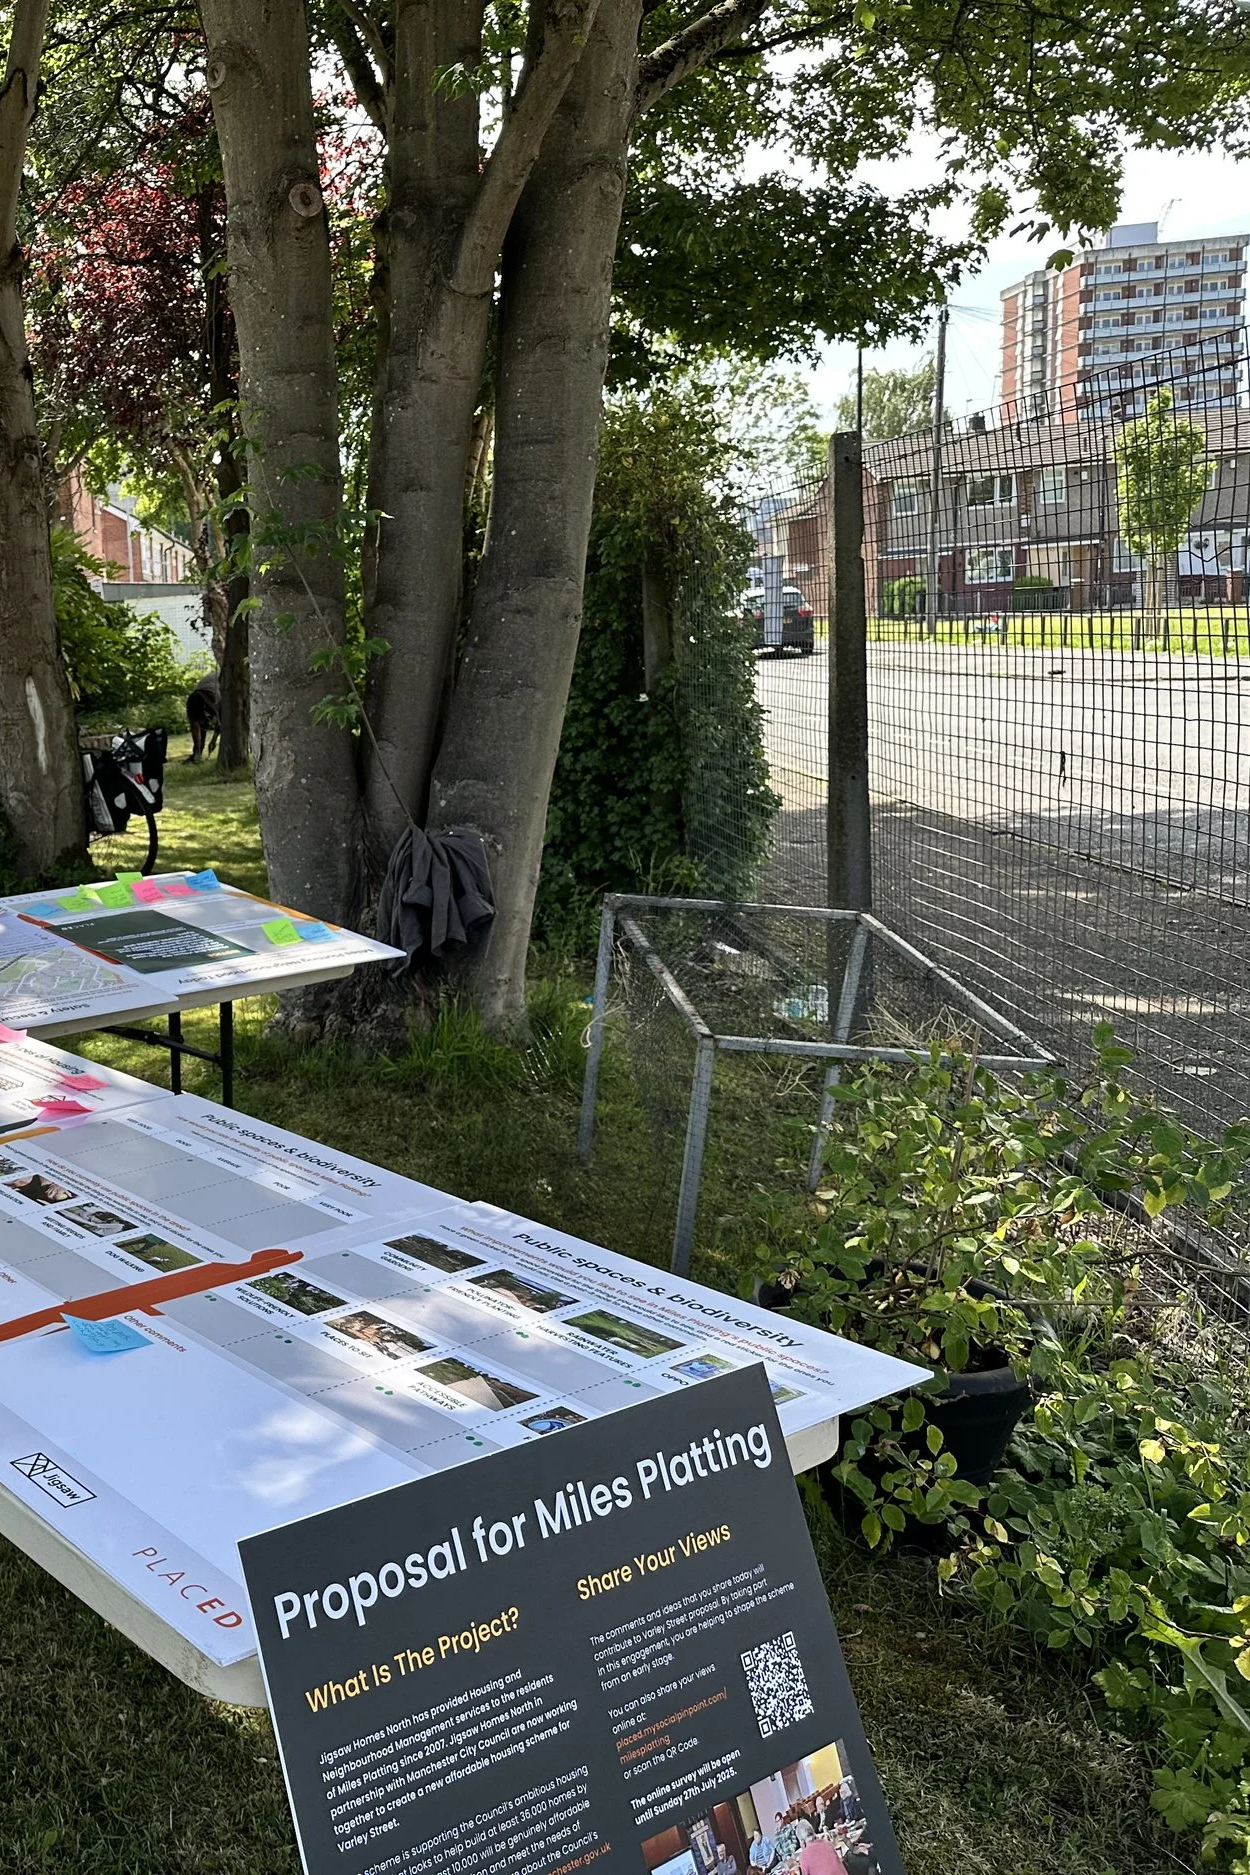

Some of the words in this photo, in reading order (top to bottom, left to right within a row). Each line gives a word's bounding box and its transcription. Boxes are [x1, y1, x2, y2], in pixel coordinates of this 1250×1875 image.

[200, 1113, 241, 1131] Public
[237, 1129, 286, 1149] spaces
[282, 1147, 299, 1155] &
[294, 1151, 382, 1188] biodiversity
[104, 1249, 121, 1259] DOG
[117, 1256, 145, 1273] WALKING
[234, 1286, 296, 1318] WILDLIFE-FRIENDLY
[511, 1232, 573, 1259] Public
[571, 1257, 647, 1288] spaces
[646, 1286, 666, 1297] &
[665, 1293, 804, 1348] biodiversity
[123, 1314, 147, 1329] Other
[143, 1327, 187, 1353] comments
[318, 1330, 350, 1347] PLACES
[348, 1344, 360, 1352] TO
[358, 1350, 372, 1358] SIT
[538, 1325, 590, 1350] HARVESTING
[587, 1347, 634, 1369] FEATURES
[566, 1331, 619, 1356] RAINWATER
[408, 1384, 456, 1411] PATHWAYS
[417, 1381, 468, 1408] ACCESSIBLE
[42, 1473, 81, 1500] Jigsaw
[274, 1527, 466, 1639] Proposal
[472, 1513, 526, 1562] for
[534, 1477, 632, 1538] Miles
[636, 1423, 771, 1499] Platting
[131, 1546, 243, 1628] PLACED
[577, 1566, 632, 1599] Share
[633, 1546, 675, 1575] Your
[678, 1525, 730, 1556] Views
[590, 1635, 604, 1645] The
[605, 1617, 645, 1639] comments
[646, 1609, 661, 1621] and
[662, 1601, 682, 1614] ideas
[682, 1593, 698, 1605] that
[698, 1589, 711, 1601] you
[712, 1579, 732, 1593] share
[732, 1570, 752, 1584] today
[594, 1639, 632, 1661] contribute
[633, 1635, 641, 1643] to
[642, 1624, 664, 1639] Varley
[666, 1613, 687, 1629] Street
[721, 1595, 729, 1604] By
[730, 1586, 752, 1600] taking
[752, 1578, 767, 1593] part
[597, 1667, 605, 1676] in
[606, 1660, 620, 1672] this
[670, 1632, 684, 1645] you
[685, 1626, 697, 1636] are
[698, 1614, 725, 1630] helping
[724, 1610, 732, 1618] to
[733, 1600, 754, 1615] shape
[755, 1594, 767, 1604] the
[767, 1582, 794, 1599] scheme
[305, 1670, 369, 1712] What
[372, 1664, 391, 1686] Is
[394, 1647, 434, 1675] The
[438, 1607, 518, 1658] Project?
[601, 1677, 620, 1690] from
[621, 1672, 631, 1682] an
[632, 1663, 650, 1676] early
[651, 1653, 674, 1668] stage.
[319, 1744, 351, 1764] Jigsaw
[353, 1730, 385, 1749] Homes
[386, 1718, 411, 1735] North
[412, 1711, 429, 1724] has
[430, 1691, 468, 1719] provided
[469, 1678, 504, 1699] Housing
[505, 1668, 521, 1683] and
[608, 1707, 623, 1718] You
[624, 1700, 639, 1711] can
[640, 1692, 655, 1704] also
[656, 1681, 677, 1696] share
[678, 1673, 694, 1689] your
[695, 1664, 715, 1678] views
[322, 1743, 394, 1782] Neighbourhood
[395, 1717, 454, 1750] Management
[455, 1702, 490, 1723] services
[491, 1698, 500, 1707] to
[501, 1691, 515, 1703] the
[516, 1674, 553, 1696] residents
[326, 1786, 335, 1799] of
[337, 1778, 361, 1795] Miles
[362, 1762, 398, 1783] Platting
[399, 1751, 423, 1767] since
[424, 1738, 448, 1756] 2007.
[449, 1725, 478, 1745] Jigsaw
[479, 1712, 509, 1731] Homes
[510, 1700, 533, 1717] North
[533, 1697, 542, 1706] in
[612, 1718, 635, 1734] online
[620, 1735, 670, 1764] milesplatting
[330, 1787, 384, 1820] partnership
[385, 1777, 405, 1792] with
[406, 1753, 457, 1783] Manchester
[459, 1745, 476, 1758] City
[478, 1728, 510, 1749] Council
[511, 1723, 525, 1735] are
[526, 1714, 543, 1728] now
[544, 1699, 577, 1719] working
[334, 1810, 373, 1835] together
[375, 1806, 385, 1816] to
[386, 1792, 416, 1810] create
[417, 1788, 424, 1796] a
[425, 1778, 443, 1793] new
[445, 1757, 489, 1784] affordable
[490, 1741, 525, 1763] housing
[525, 1726, 557, 1746] scheme
[558, 1720, 569, 1731] for
[624, 1770, 631, 1779] or
[633, 1760, 652, 1774] scan
[652, 1754, 665, 1765] the
[666, 1746, 677, 1758] QR
[630, 1797, 646, 1809] The
[646, 1785, 670, 1801] online
[671, 1771, 696, 1789] survey
[697, 1762, 711, 1776] will
[710, 1759, 721, 1769] be
[721, 1749, 740, 1764] open
[635, 1808, 653, 1824] until
[653, 1795, 682, 1815] Sunday
[683, 1785, 700, 1800] 27th
[701, 1777, 716, 1791] July
[716, 1767, 737, 1783] 2025.
[337, 1832, 367, 1852] Varley
[369, 1818, 399, 1837] Street.
